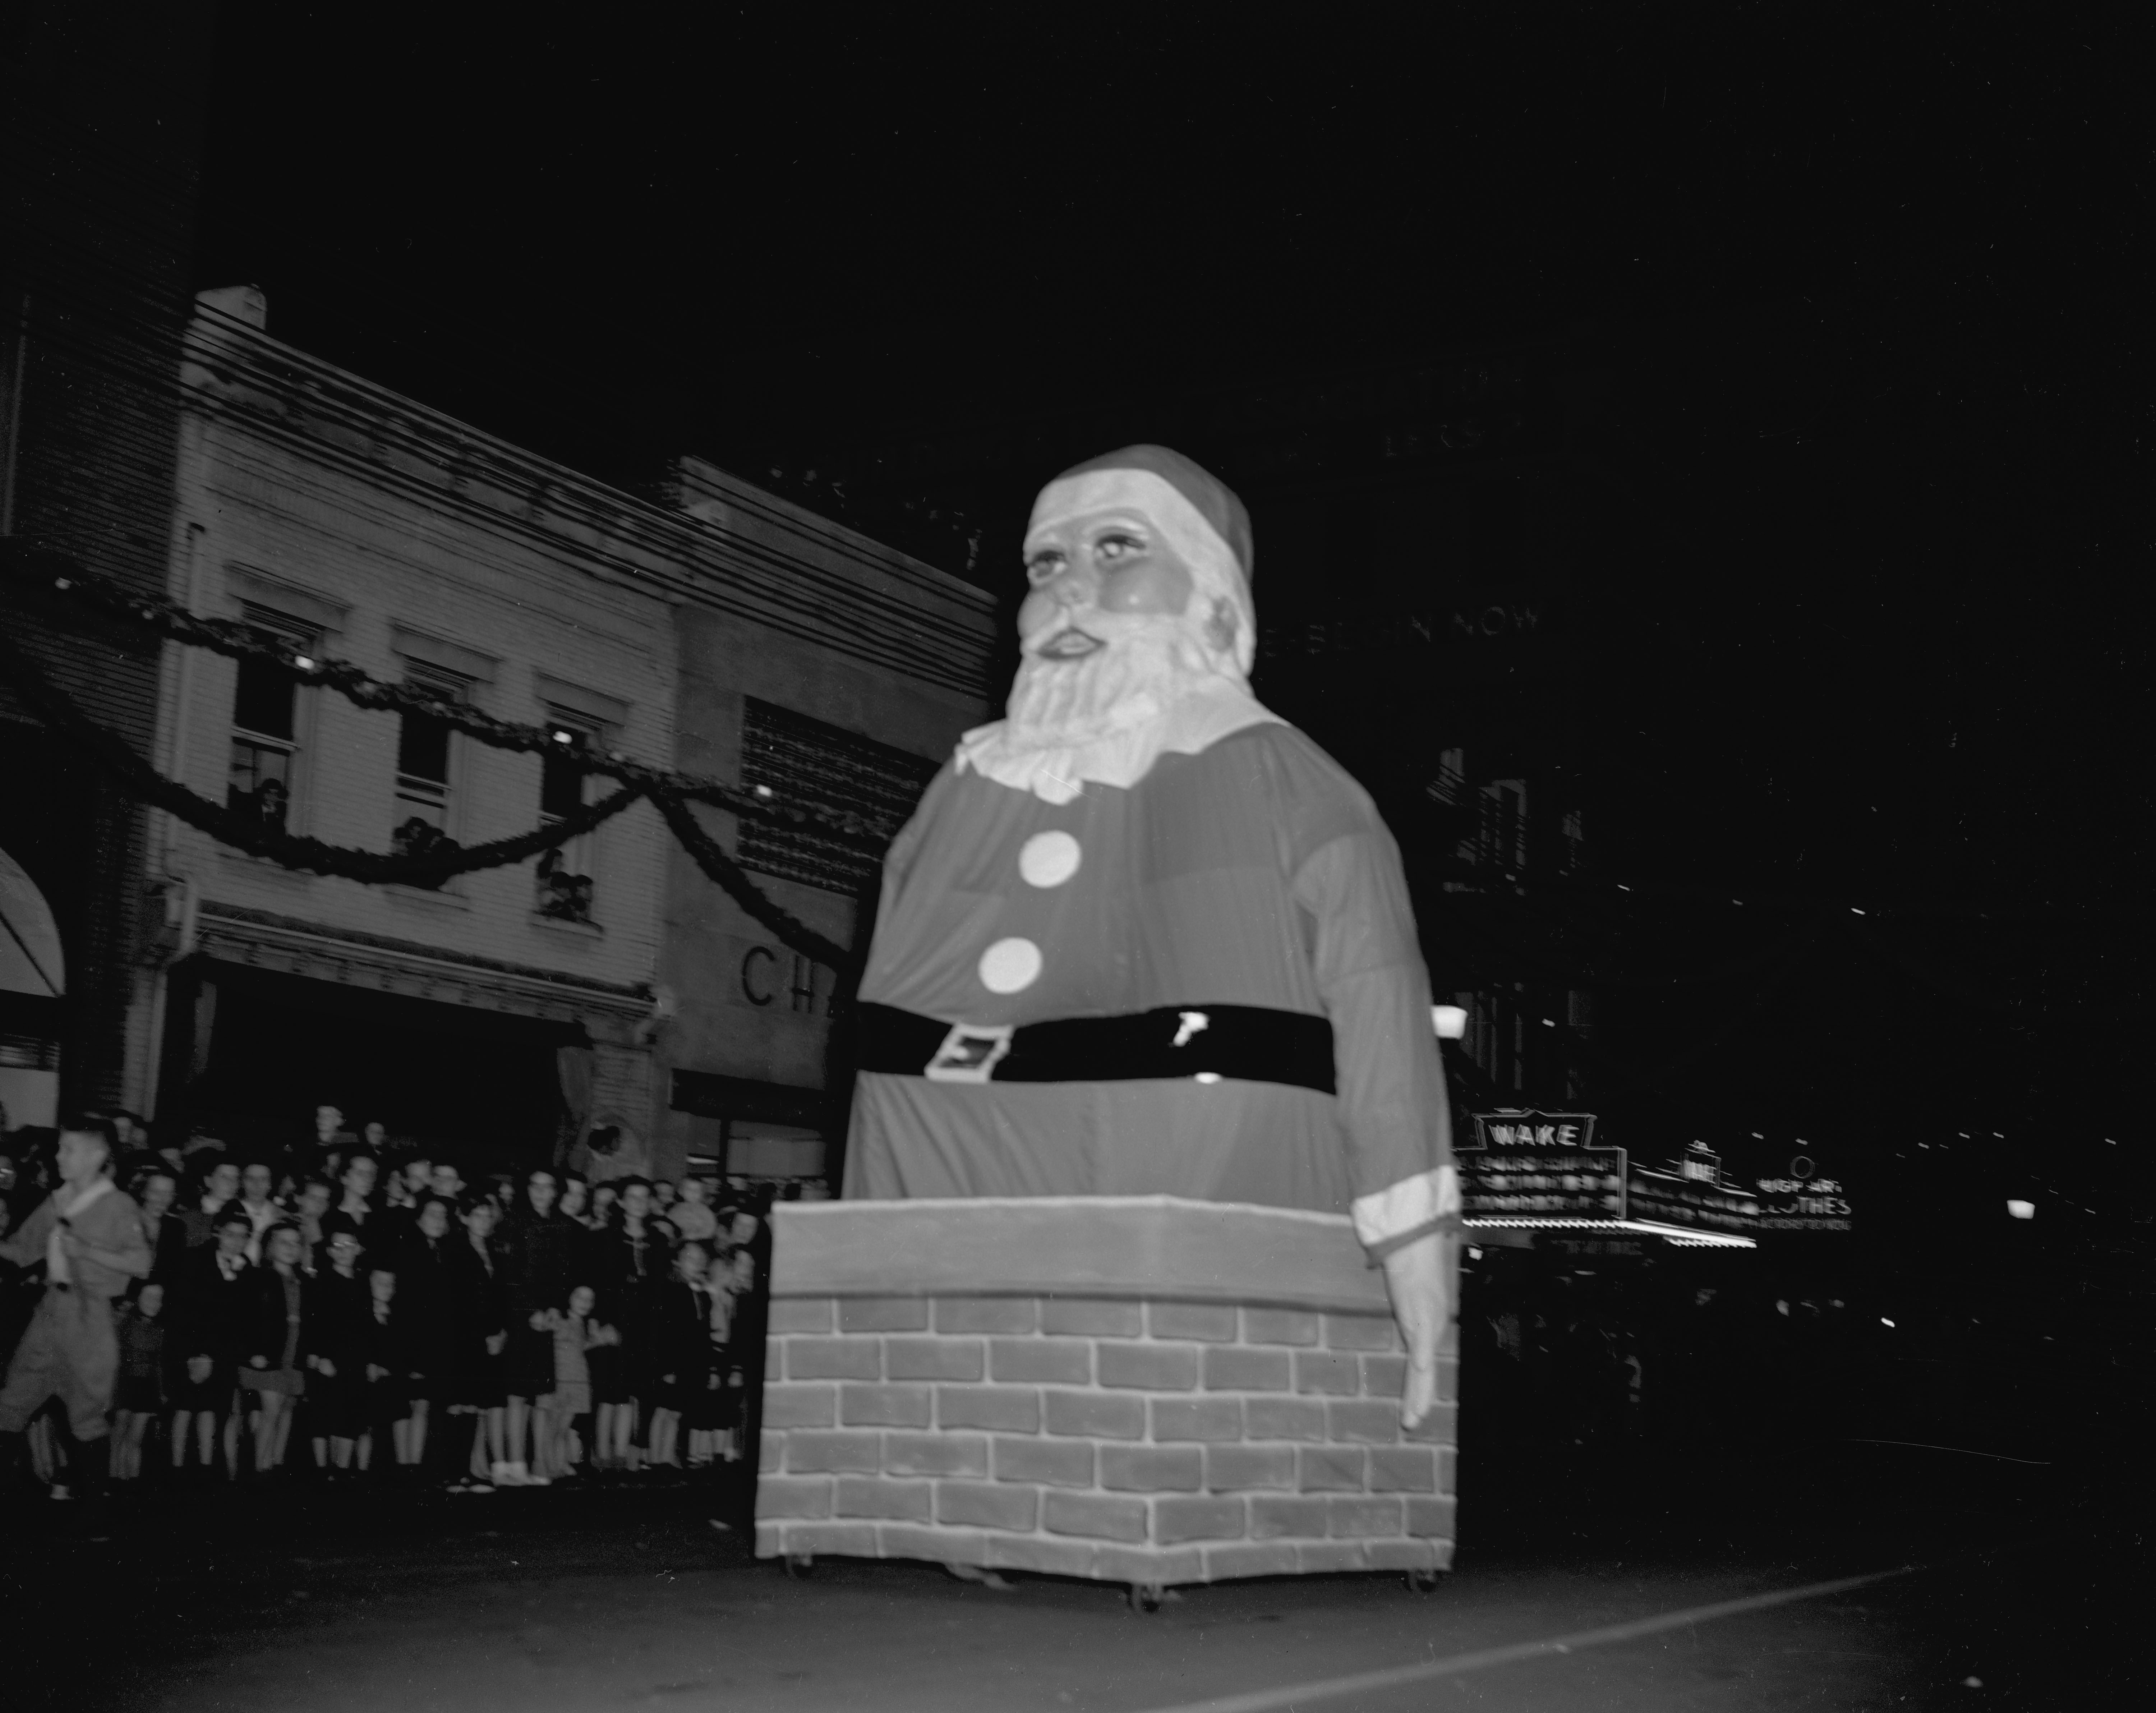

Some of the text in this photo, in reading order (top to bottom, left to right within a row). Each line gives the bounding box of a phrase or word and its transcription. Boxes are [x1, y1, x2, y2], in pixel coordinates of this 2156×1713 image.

[1069, 404, 1184, 456] LOAN
[1207, 356, 1527, 437] ASSOCIATION
[1449, 601, 1544, 643] NOW
[1488, 1124, 1580, 1146] WAKE
